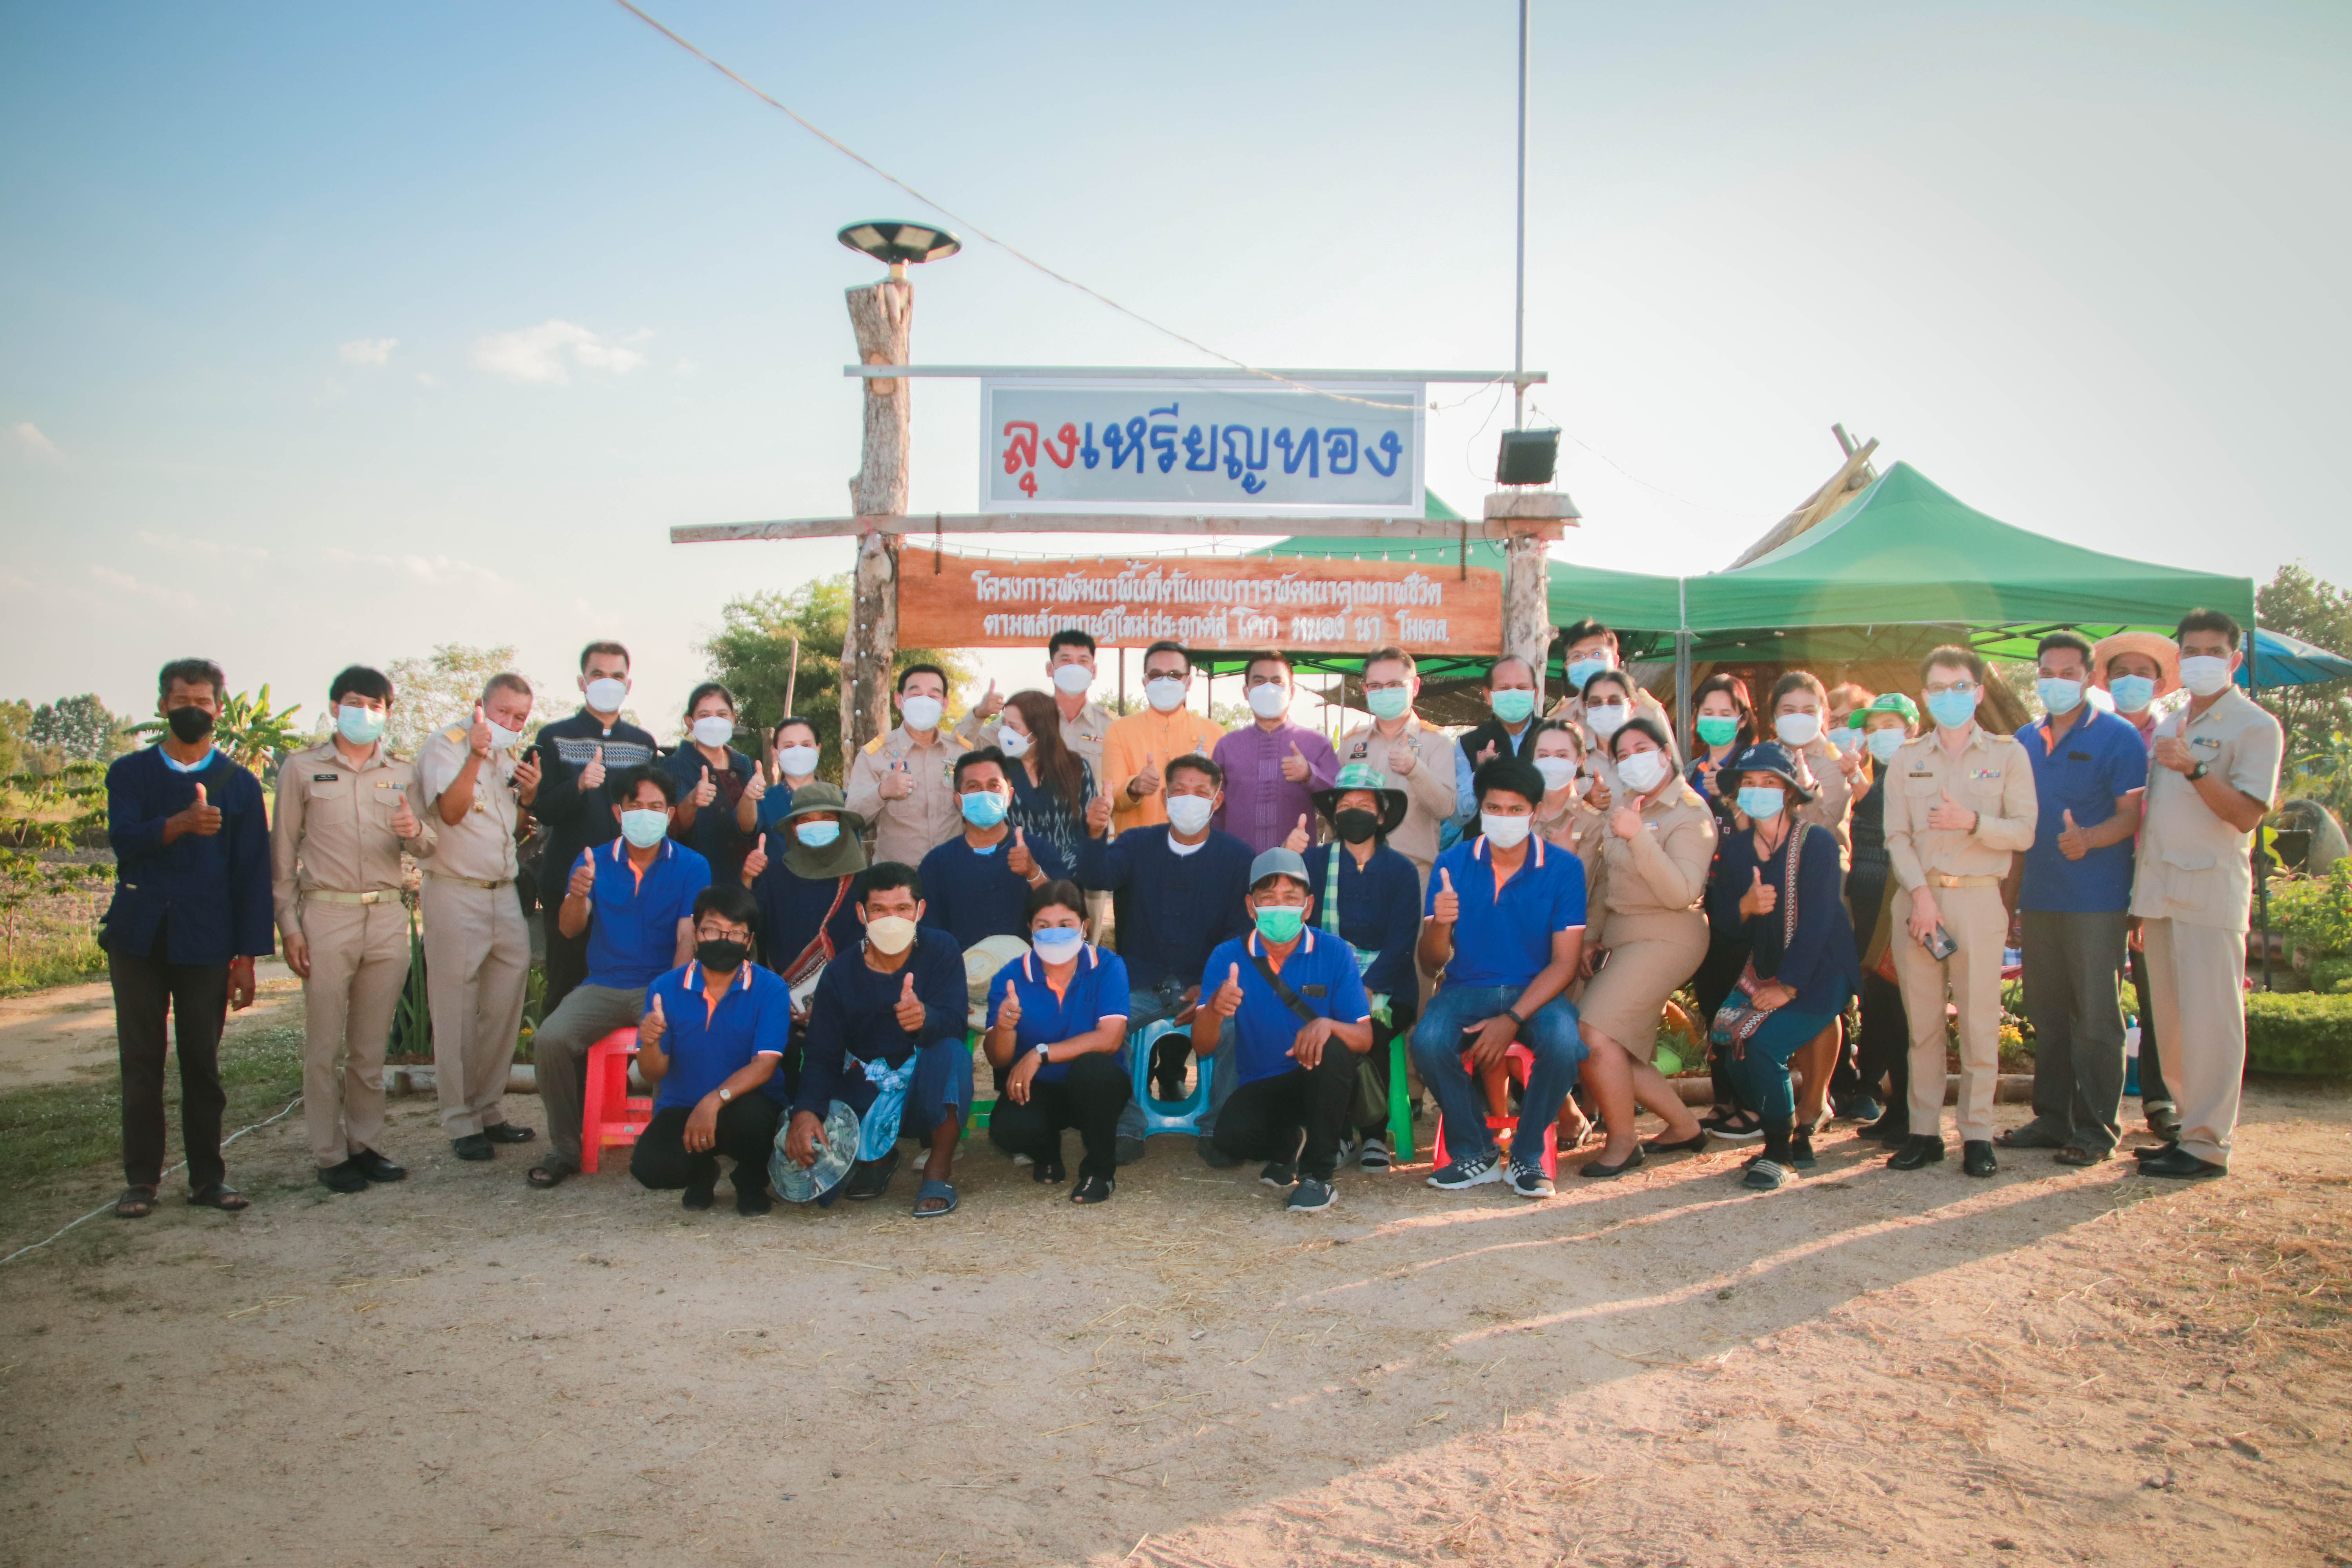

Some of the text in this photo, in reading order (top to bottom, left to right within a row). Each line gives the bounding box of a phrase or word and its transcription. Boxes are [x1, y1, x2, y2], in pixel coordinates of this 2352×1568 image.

[971, 559, 1442, 614] โครงการพัฒนาพื้นที่ต้นแบบการพัฒนาคุณภาพชีวิต
[1229, 606, 1279, 640] โคก
[1291, 615, 1346, 642] หนอง
[1354, 615, 1381, 642] นา
